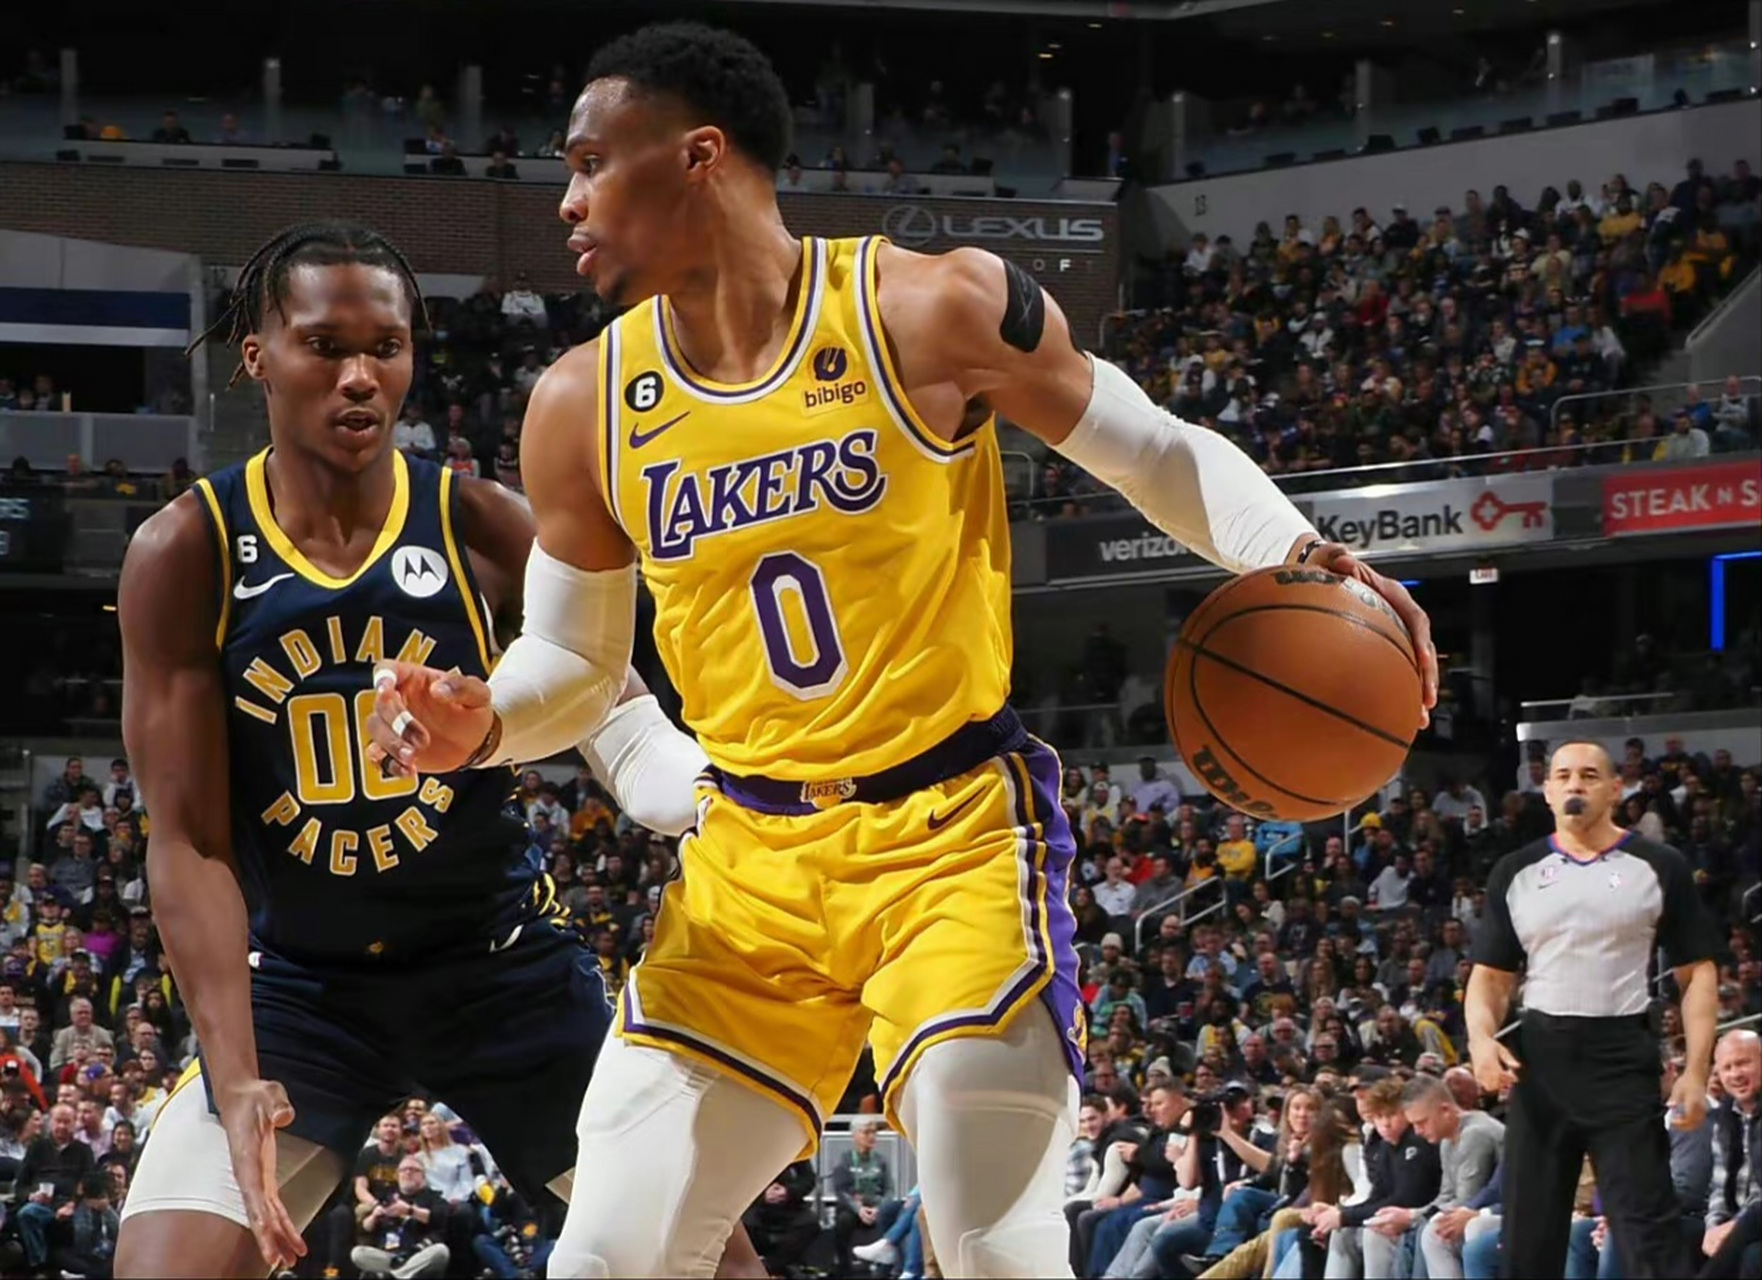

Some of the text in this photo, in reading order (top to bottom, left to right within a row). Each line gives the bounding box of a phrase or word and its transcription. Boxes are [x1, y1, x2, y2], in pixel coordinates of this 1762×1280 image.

[942, 215, 1105, 242] LEXUS
[634, 375, 657, 409] 6
[804, 380, 867, 408] bibigo
[641, 428, 889, 562] LAKERS
[1611, 483, 1711, 520] STEAK
[1716, 486, 1734, 506] N
[1317, 505, 1464, 549] KeyBank
[237, 534, 259, 563] 6
[748, 550, 849, 701] 0
[235, 615, 462, 725] INDIAN
[800, 777, 857, 804] LAKERS
[261, 776, 455, 877] PACERS
